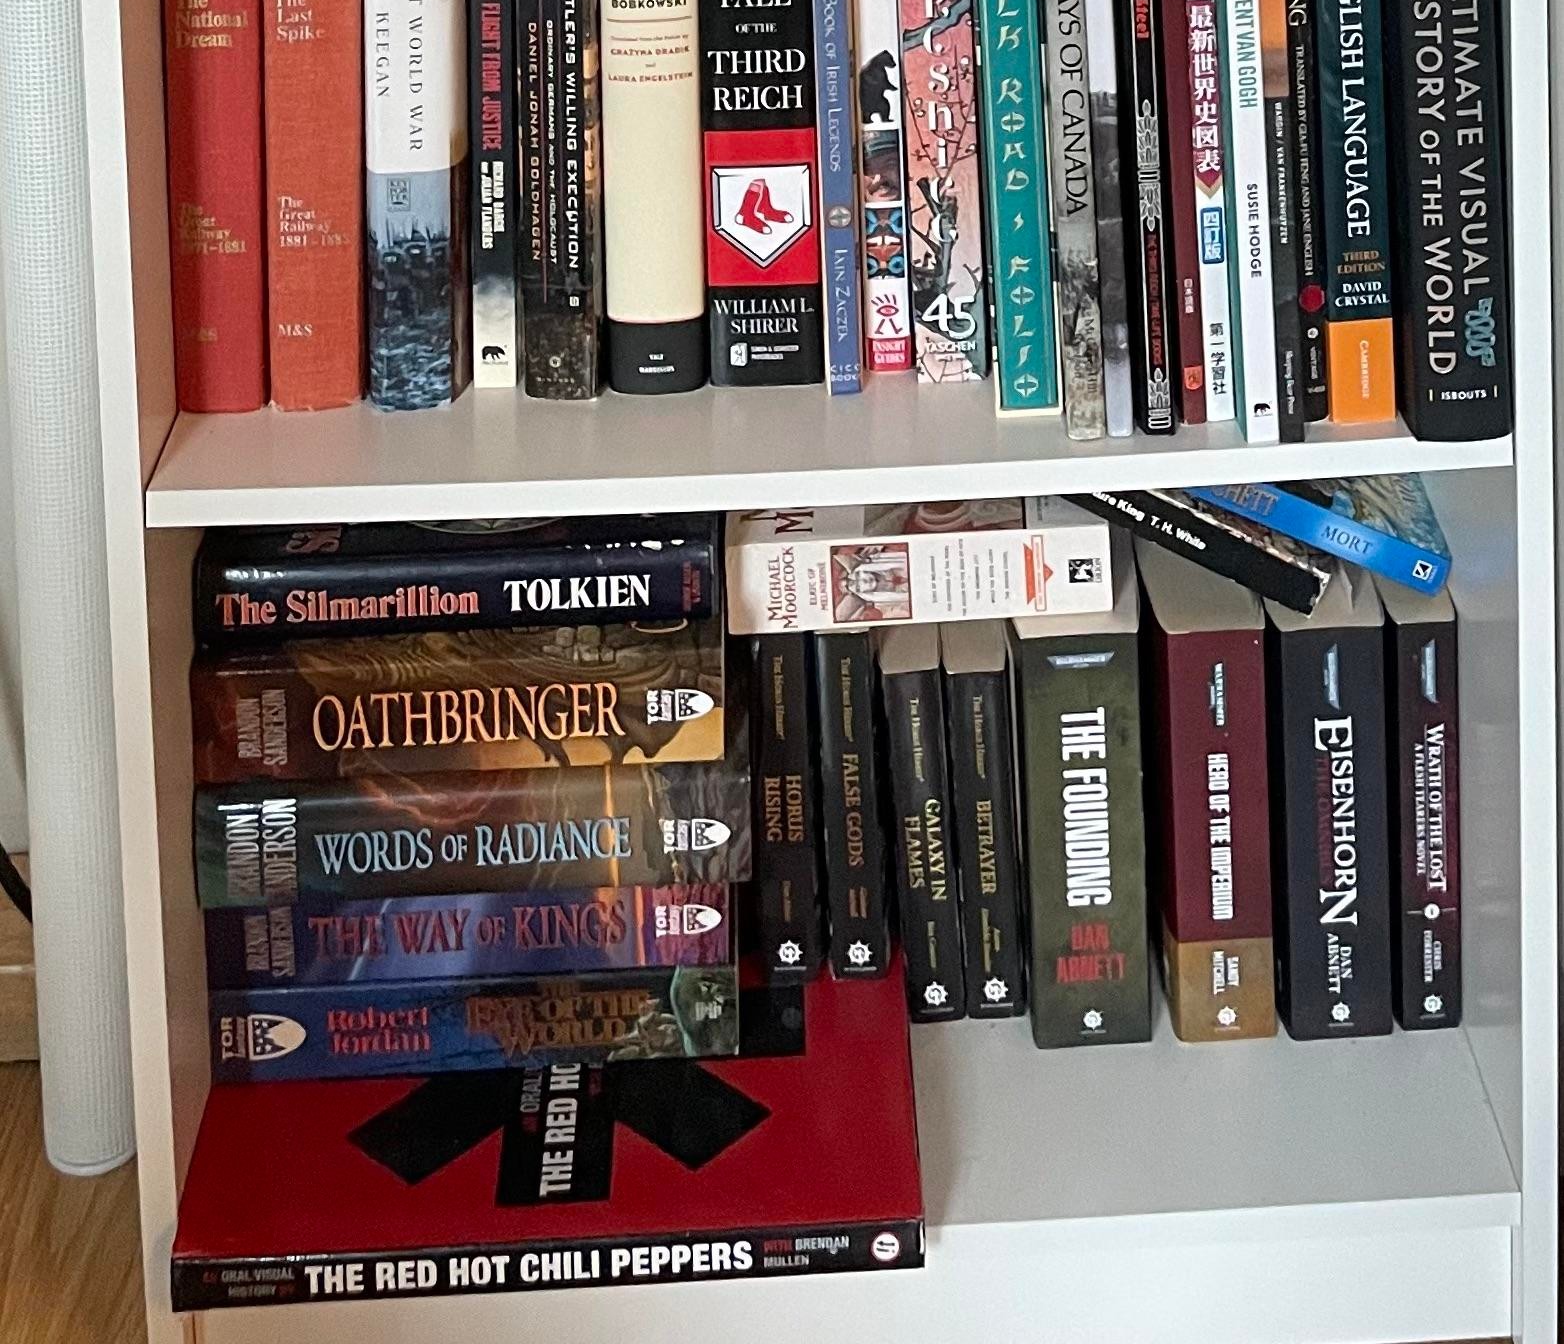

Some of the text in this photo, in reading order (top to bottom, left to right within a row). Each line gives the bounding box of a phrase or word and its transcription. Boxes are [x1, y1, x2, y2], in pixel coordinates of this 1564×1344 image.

[376, 12, 390, 98] KEEGAN
[408, 18, 423, 95] WORLD
[708, 49, 806, 74] THIRD
[713, 85, 803, 111] REICH
[409, 105, 423, 152] WAR
[1419, 130, 1443, 165] OF
[1341, 78, 1370, 237] LANGUAGE
[1421, 173, 1445, 227] THE
[1459, 158, 1489, 296] VISUAL
[731, 317, 799, 333] SHIRER
[922, 293, 976, 339] 45
[1423, 237, 1456, 374] WORLD
[1319, 524, 1373, 557] MORT
[216, 574, 651, 630] The Silmarillion TOLKIEN
[767, 556, 781, 622] MICHAEL
[312, 683, 624, 751] OATHBRINGER
[647, 690, 658, 724] TOR
[785, 775, 803, 842] HORUS
[1061, 706, 1111, 907] THE FOUNDING
[1425, 723, 1447, 892] WRATH OF THE LOST
[313, 817, 632, 875] WORDS OF RADIANCE
[1213, 951, 1225, 995] MITCHELL
[1327, 933, 1340, 993] ABNETT
[1340, 946, 1353, 978] DAN
[304, 1239, 752, 1295] THE RED HOT CHILI PEPPERS
[763, 1254, 809, 1267] MULLEN
